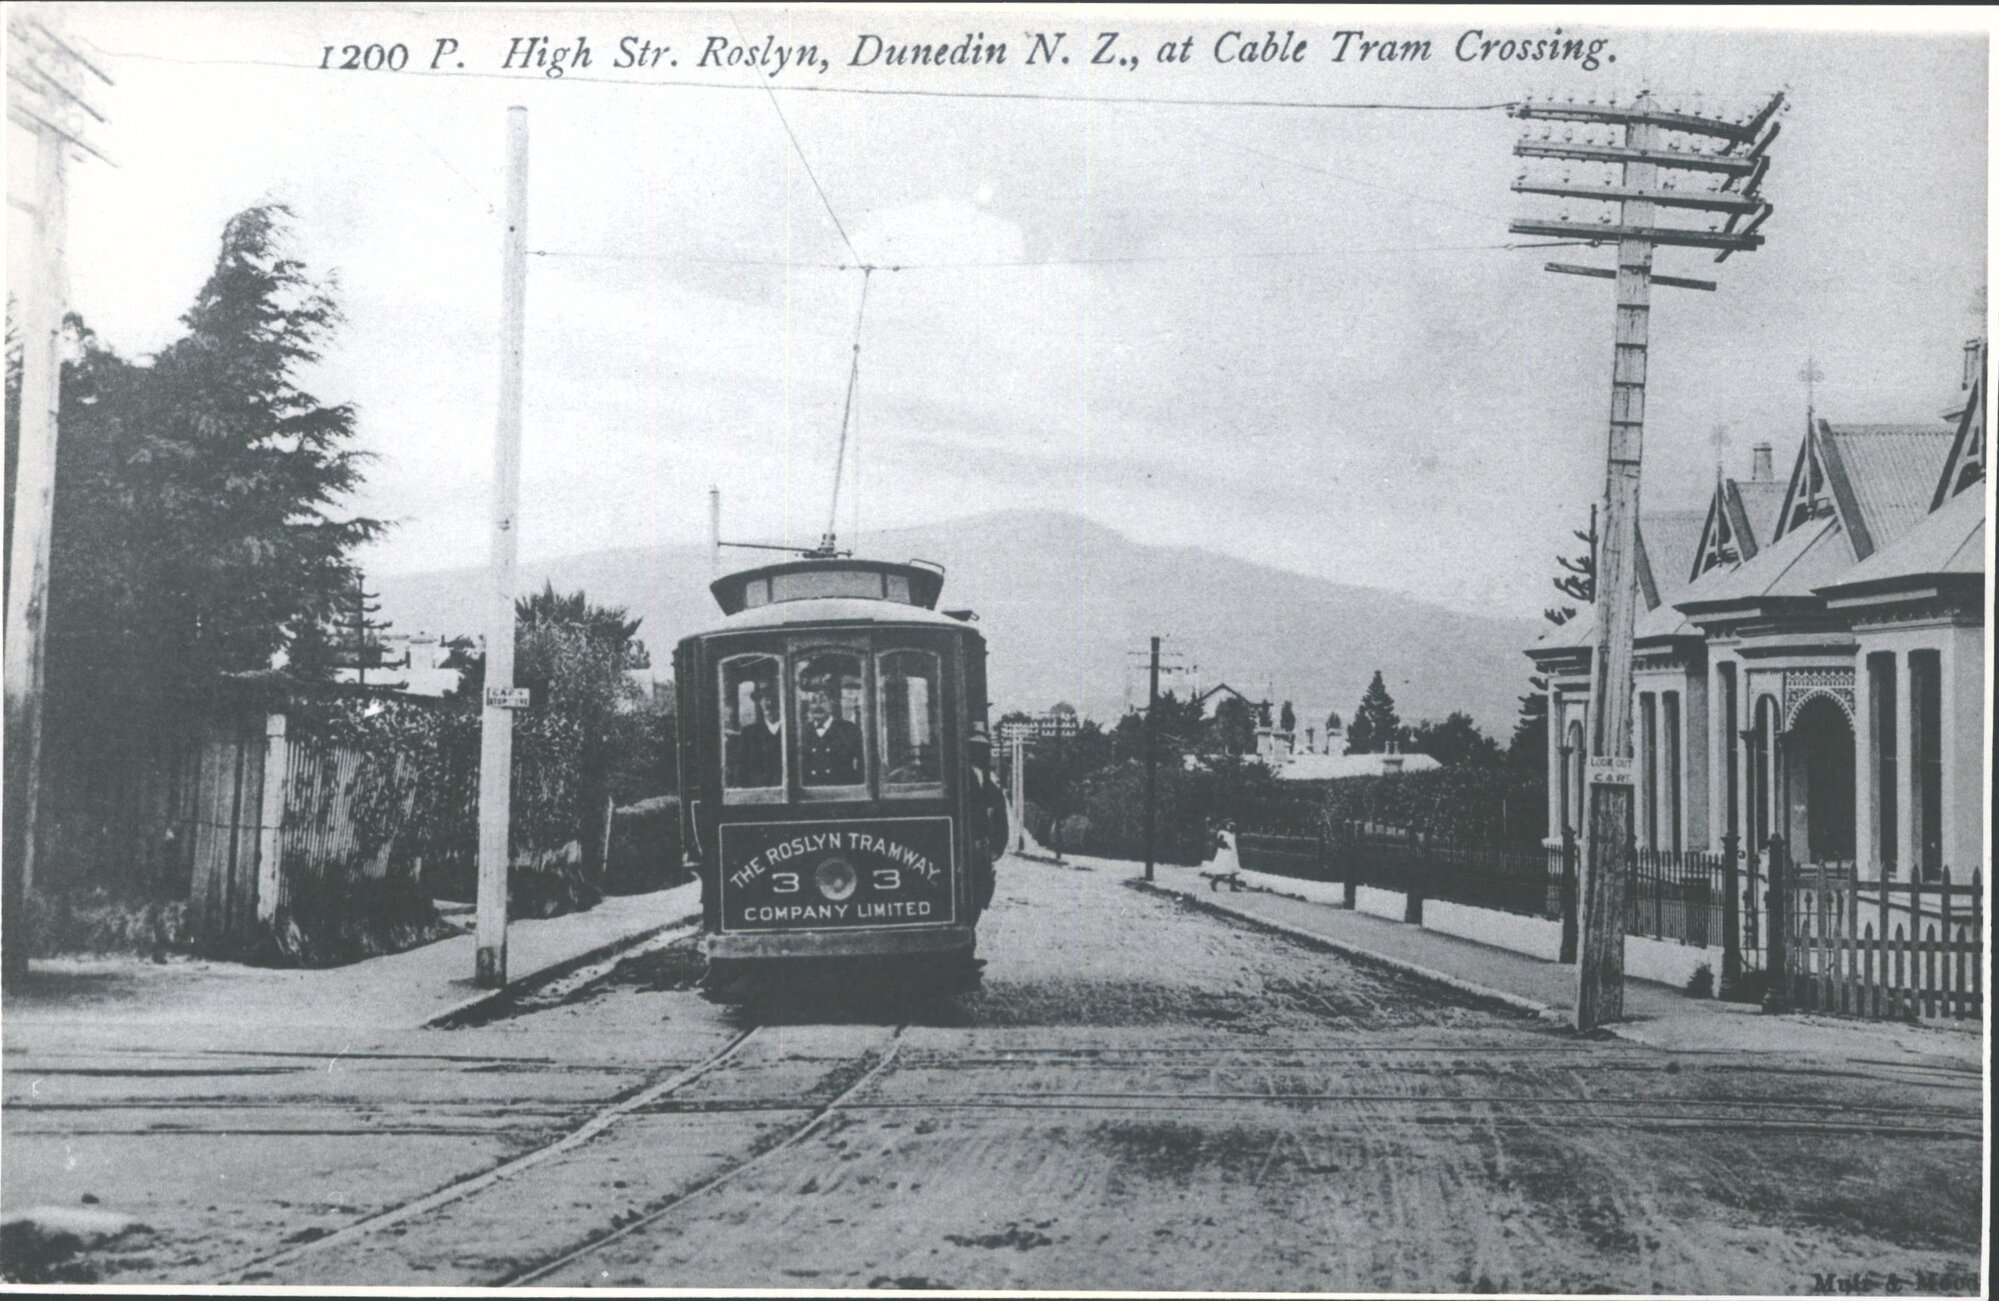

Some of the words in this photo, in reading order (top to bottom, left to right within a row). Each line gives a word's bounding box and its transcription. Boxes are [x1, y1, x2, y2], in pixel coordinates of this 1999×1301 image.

[1590, 758, 1613, 767] LOOK
[1616, 759, 1633, 768] OUT
[730, 857, 766, 888] THE
[766, 833, 841, 865] ROSLYN
[772, 872, 799, 893] 3
[872, 869, 901, 890] 3
[744, 904, 849, 922] COMPANY
[858, 901, 931, 918] LIMITED
